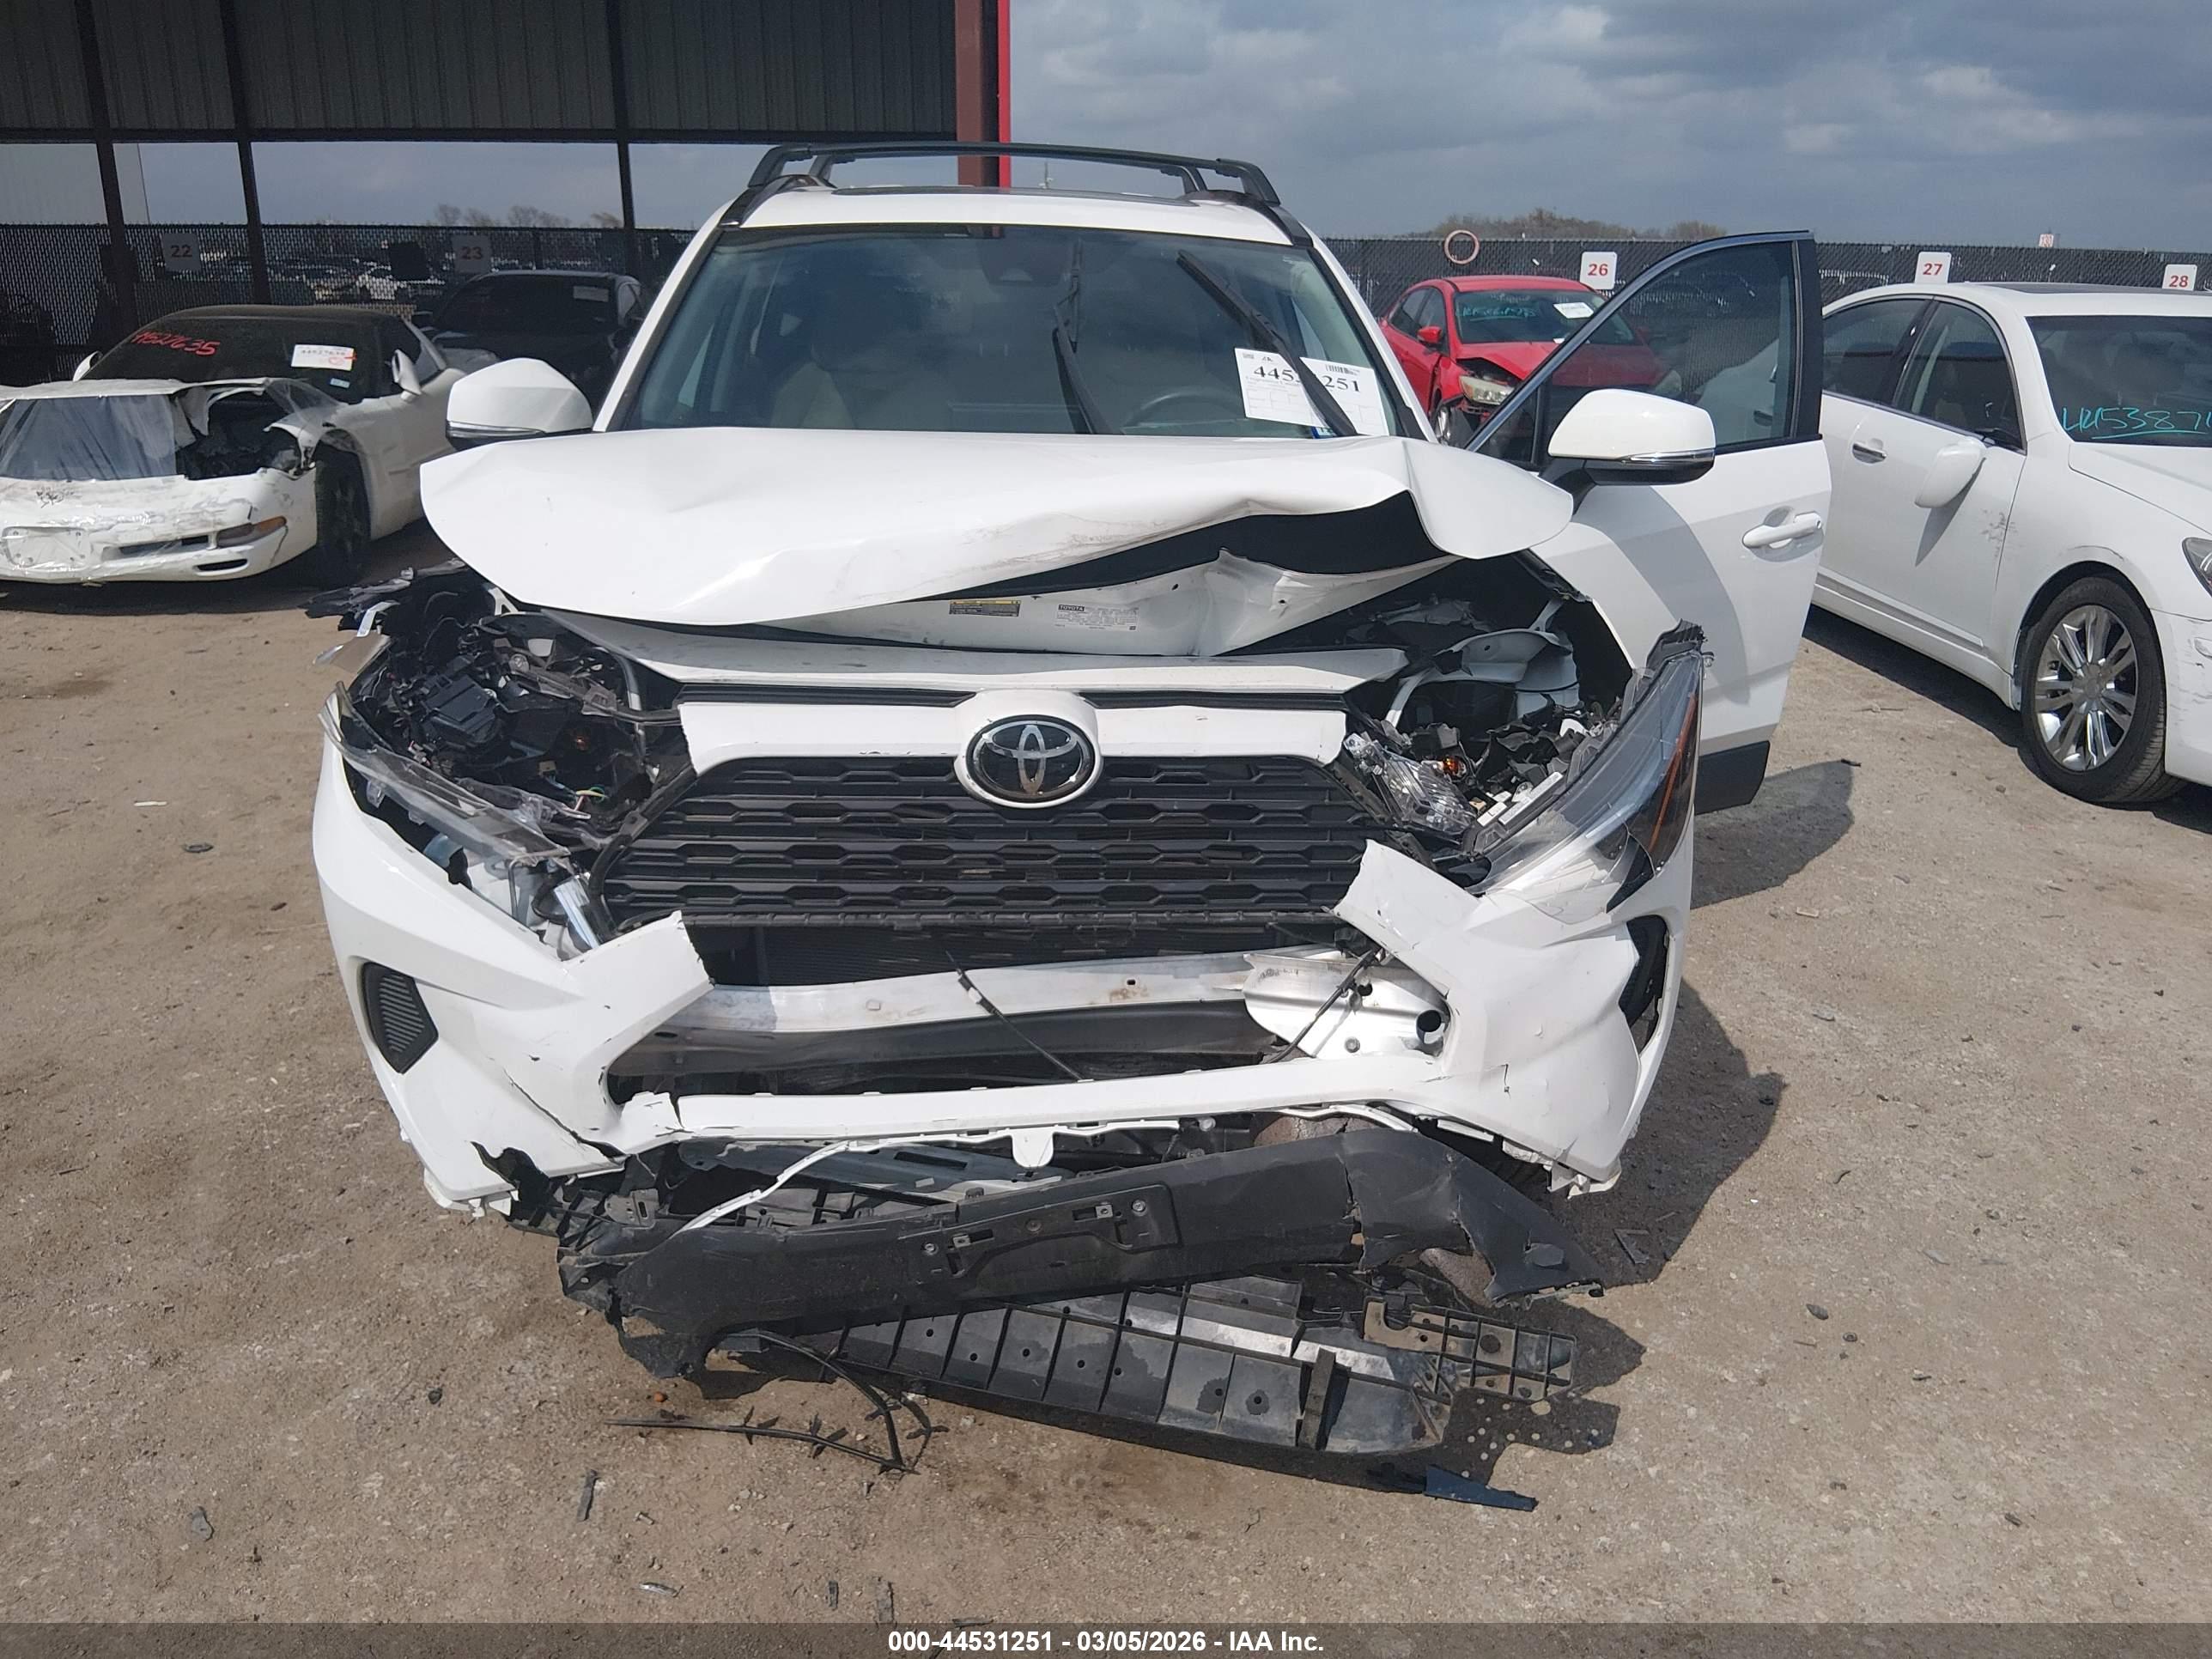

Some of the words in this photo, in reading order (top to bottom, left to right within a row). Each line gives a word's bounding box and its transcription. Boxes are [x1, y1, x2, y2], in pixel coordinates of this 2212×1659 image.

[171, 244, 193, 258] 22
[461, 246, 483, 260] 23
[1587, 263, 1608, 276] 26
[1923, 263, 1943, 276] 27
[2168, 275, 2189, 288] 28
